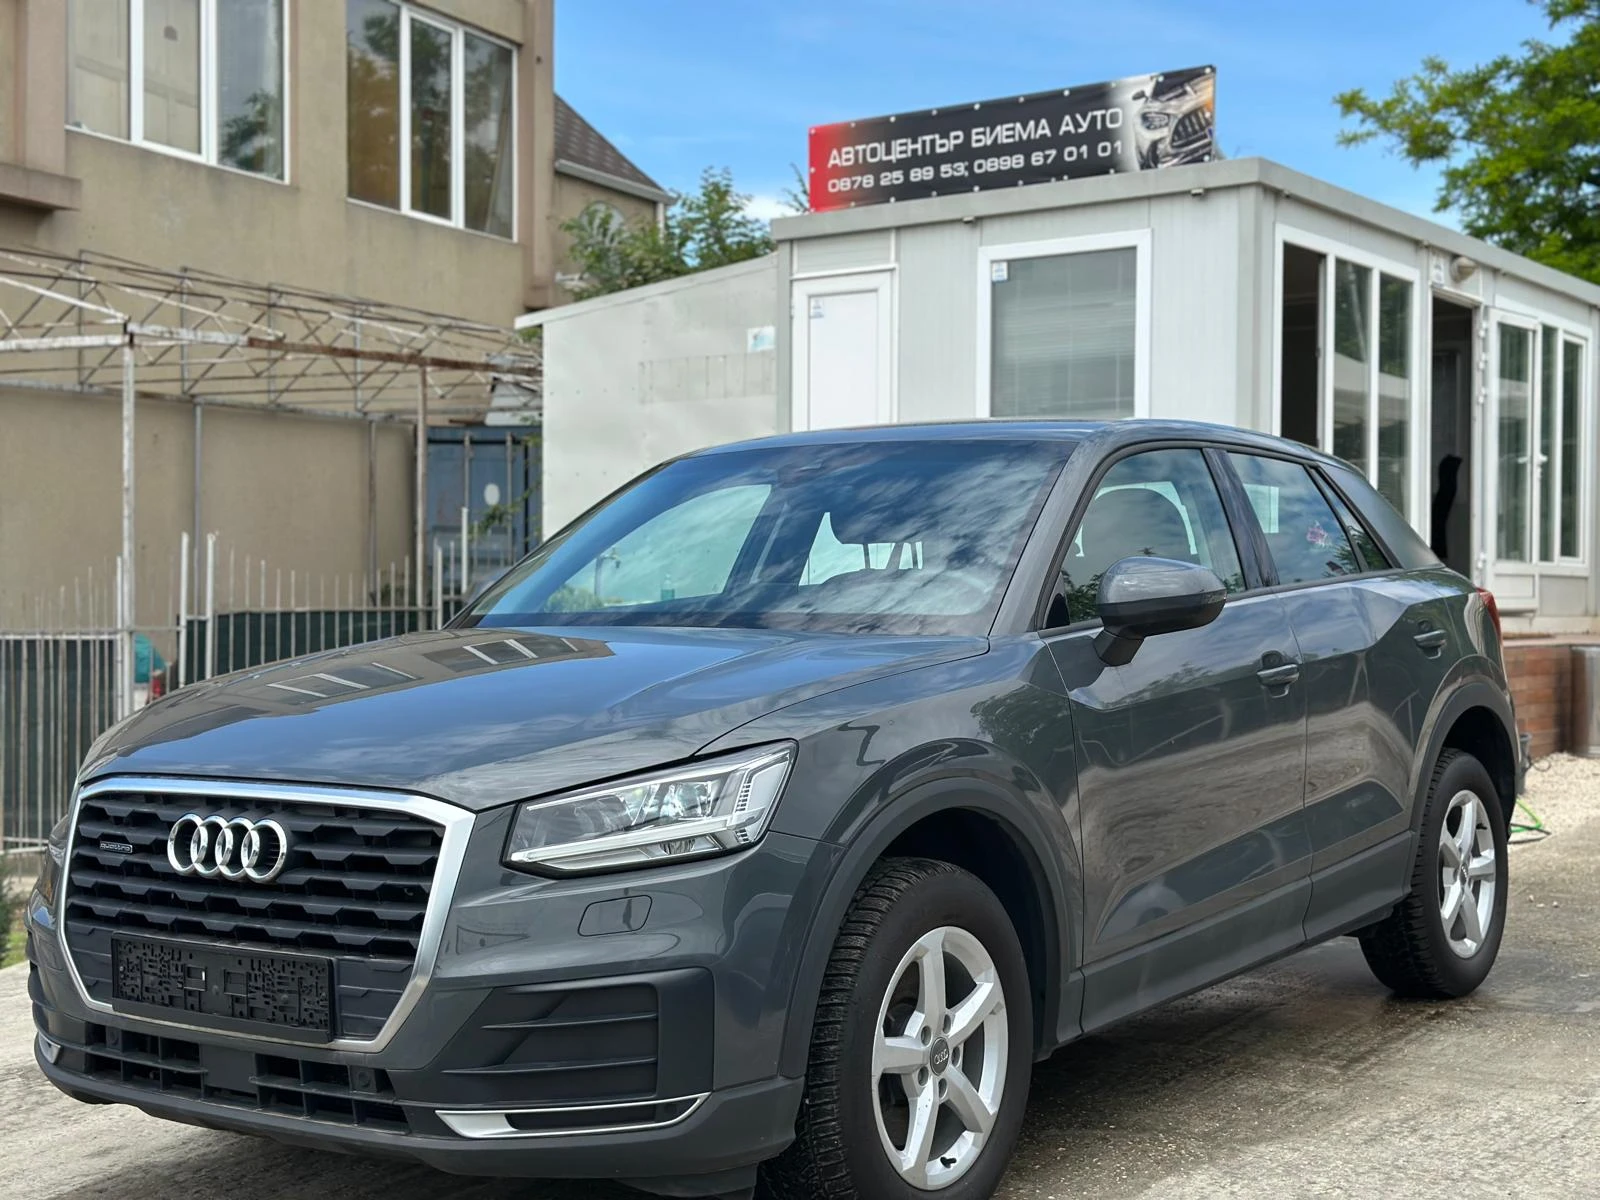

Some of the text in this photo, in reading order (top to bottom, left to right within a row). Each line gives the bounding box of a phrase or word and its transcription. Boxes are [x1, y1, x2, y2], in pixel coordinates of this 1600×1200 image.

[828, 107, 1123, 169] АВТОЦЕНТЪР БИЕМА АУТО
[828, 140, 1122, 193] 0878 25 89 53; 0898 67 01 01
